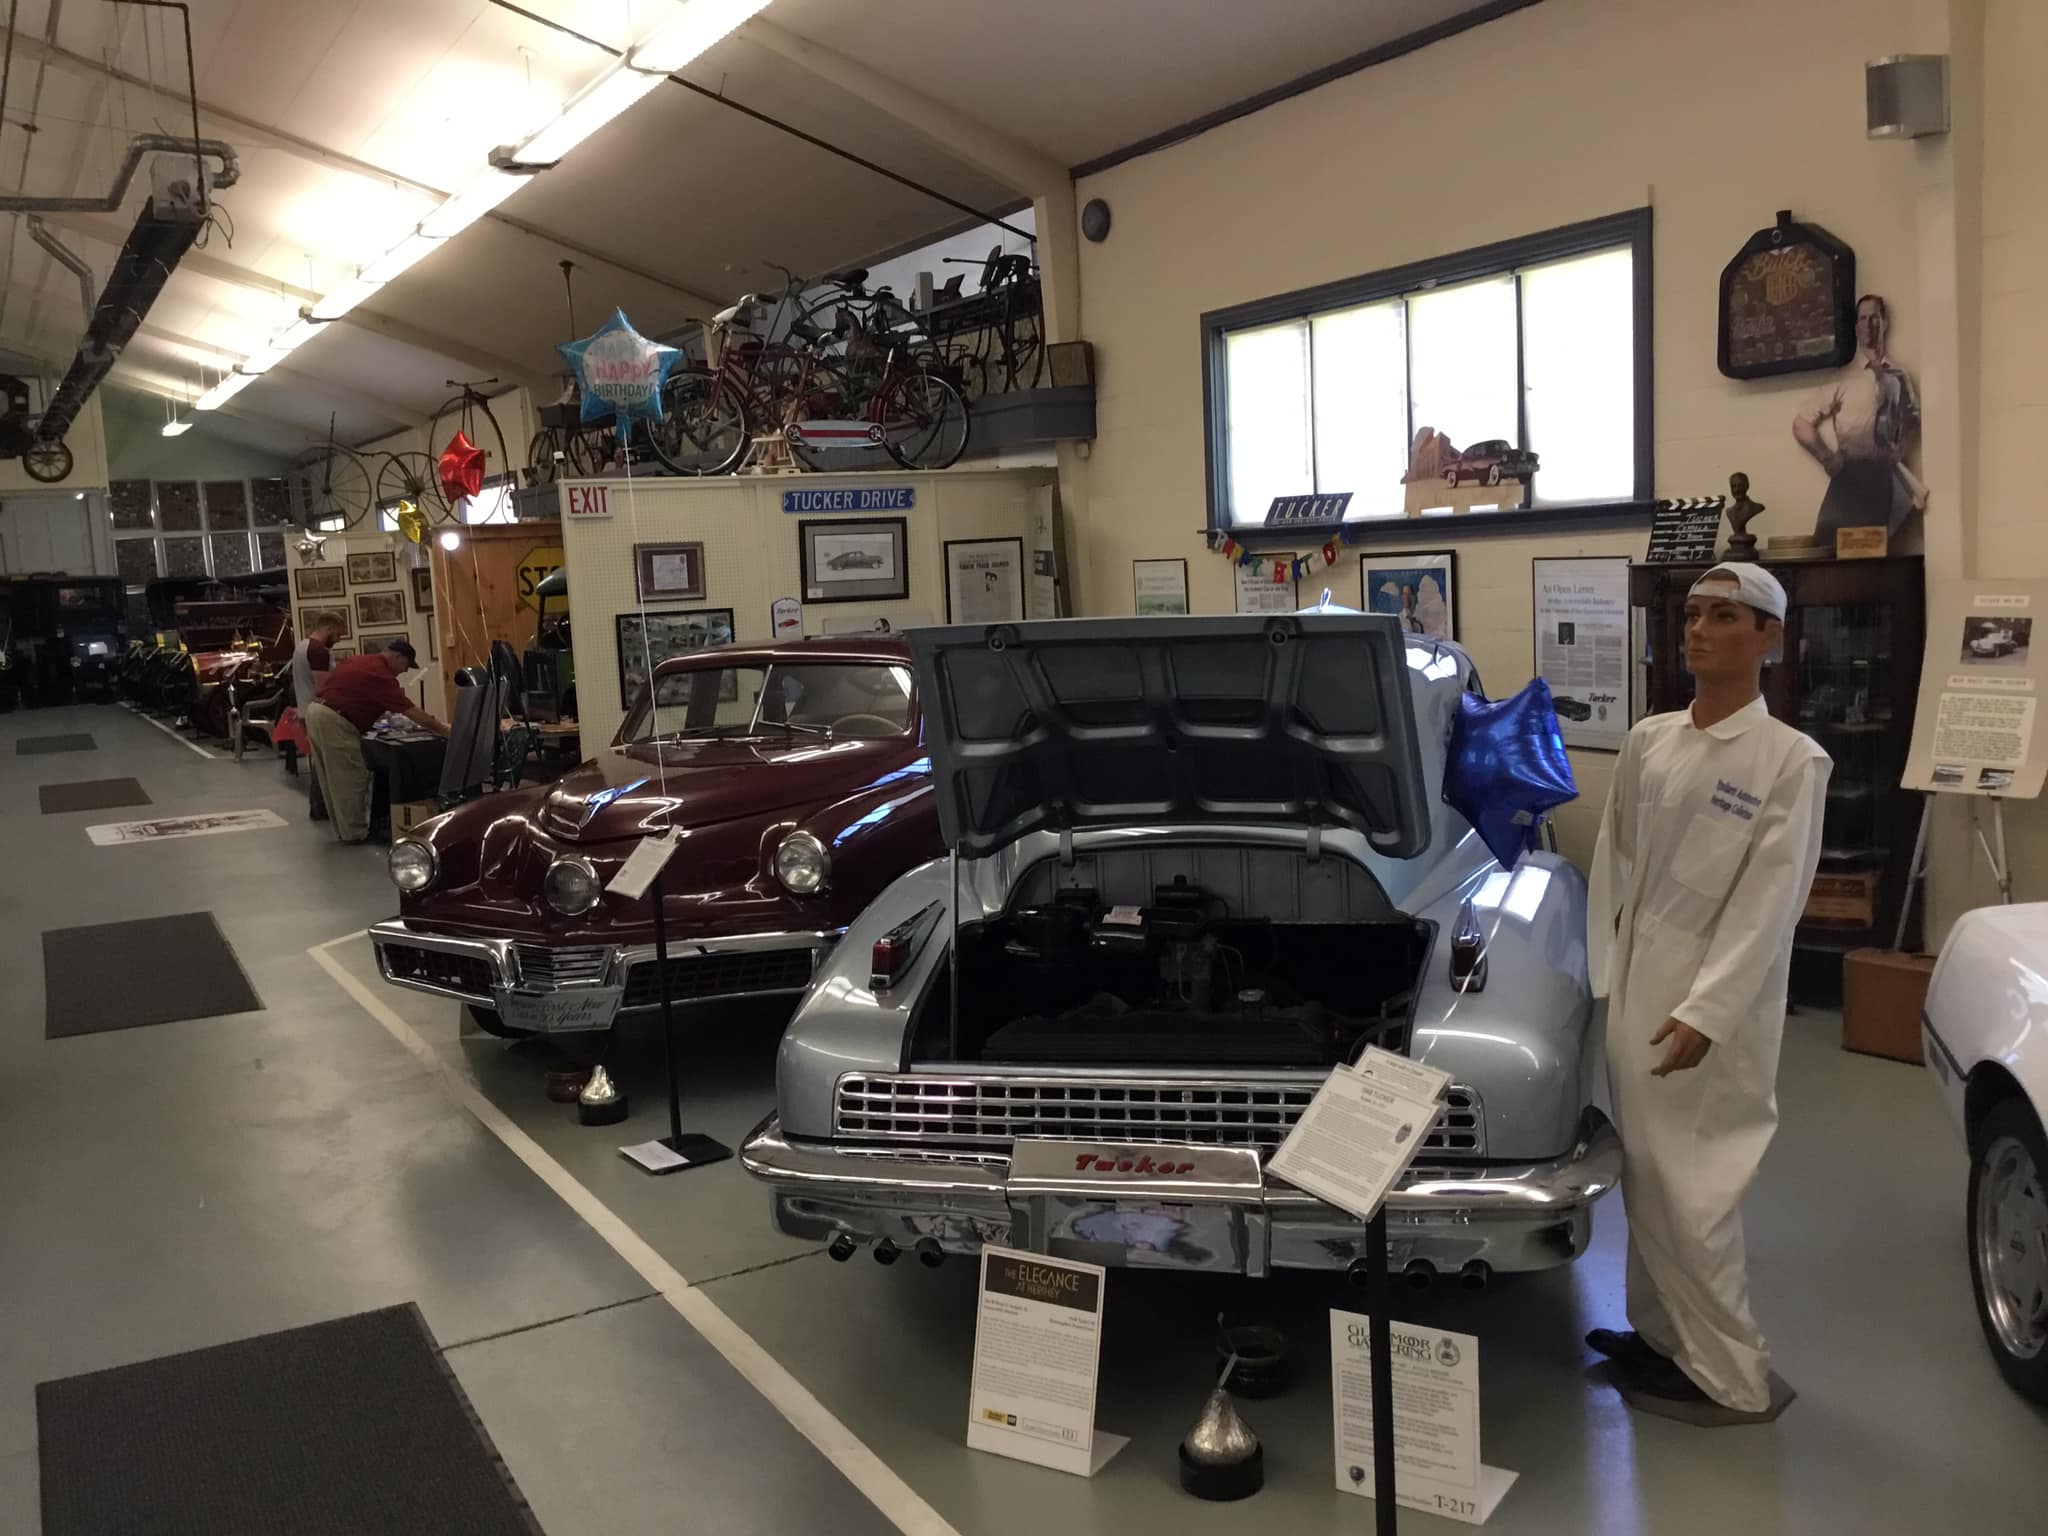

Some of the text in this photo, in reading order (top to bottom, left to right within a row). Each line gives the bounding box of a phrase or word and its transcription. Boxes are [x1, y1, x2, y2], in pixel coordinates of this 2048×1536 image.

[595, 360, 651, 381] HAPPY
[594, 384, 654, 398] BIRTHDAY!
[568, 486, 608, 514] EXIT
[792, 489, 907, 510] TUCKER DRIVE
[1273, 498, 1343, 520] TUCKER
[519, 566, 561, 597] ST
[1076, 1154, 1195, 1174] Tucker
[1018, 1264, 1080, 1292] ELEGANCE
[1347, 1323, 1432, 1351] GLMOOR
[1347, 1334, 1432, 1360] GAERING
[1434, 1494, 1476, 1515] T-217
